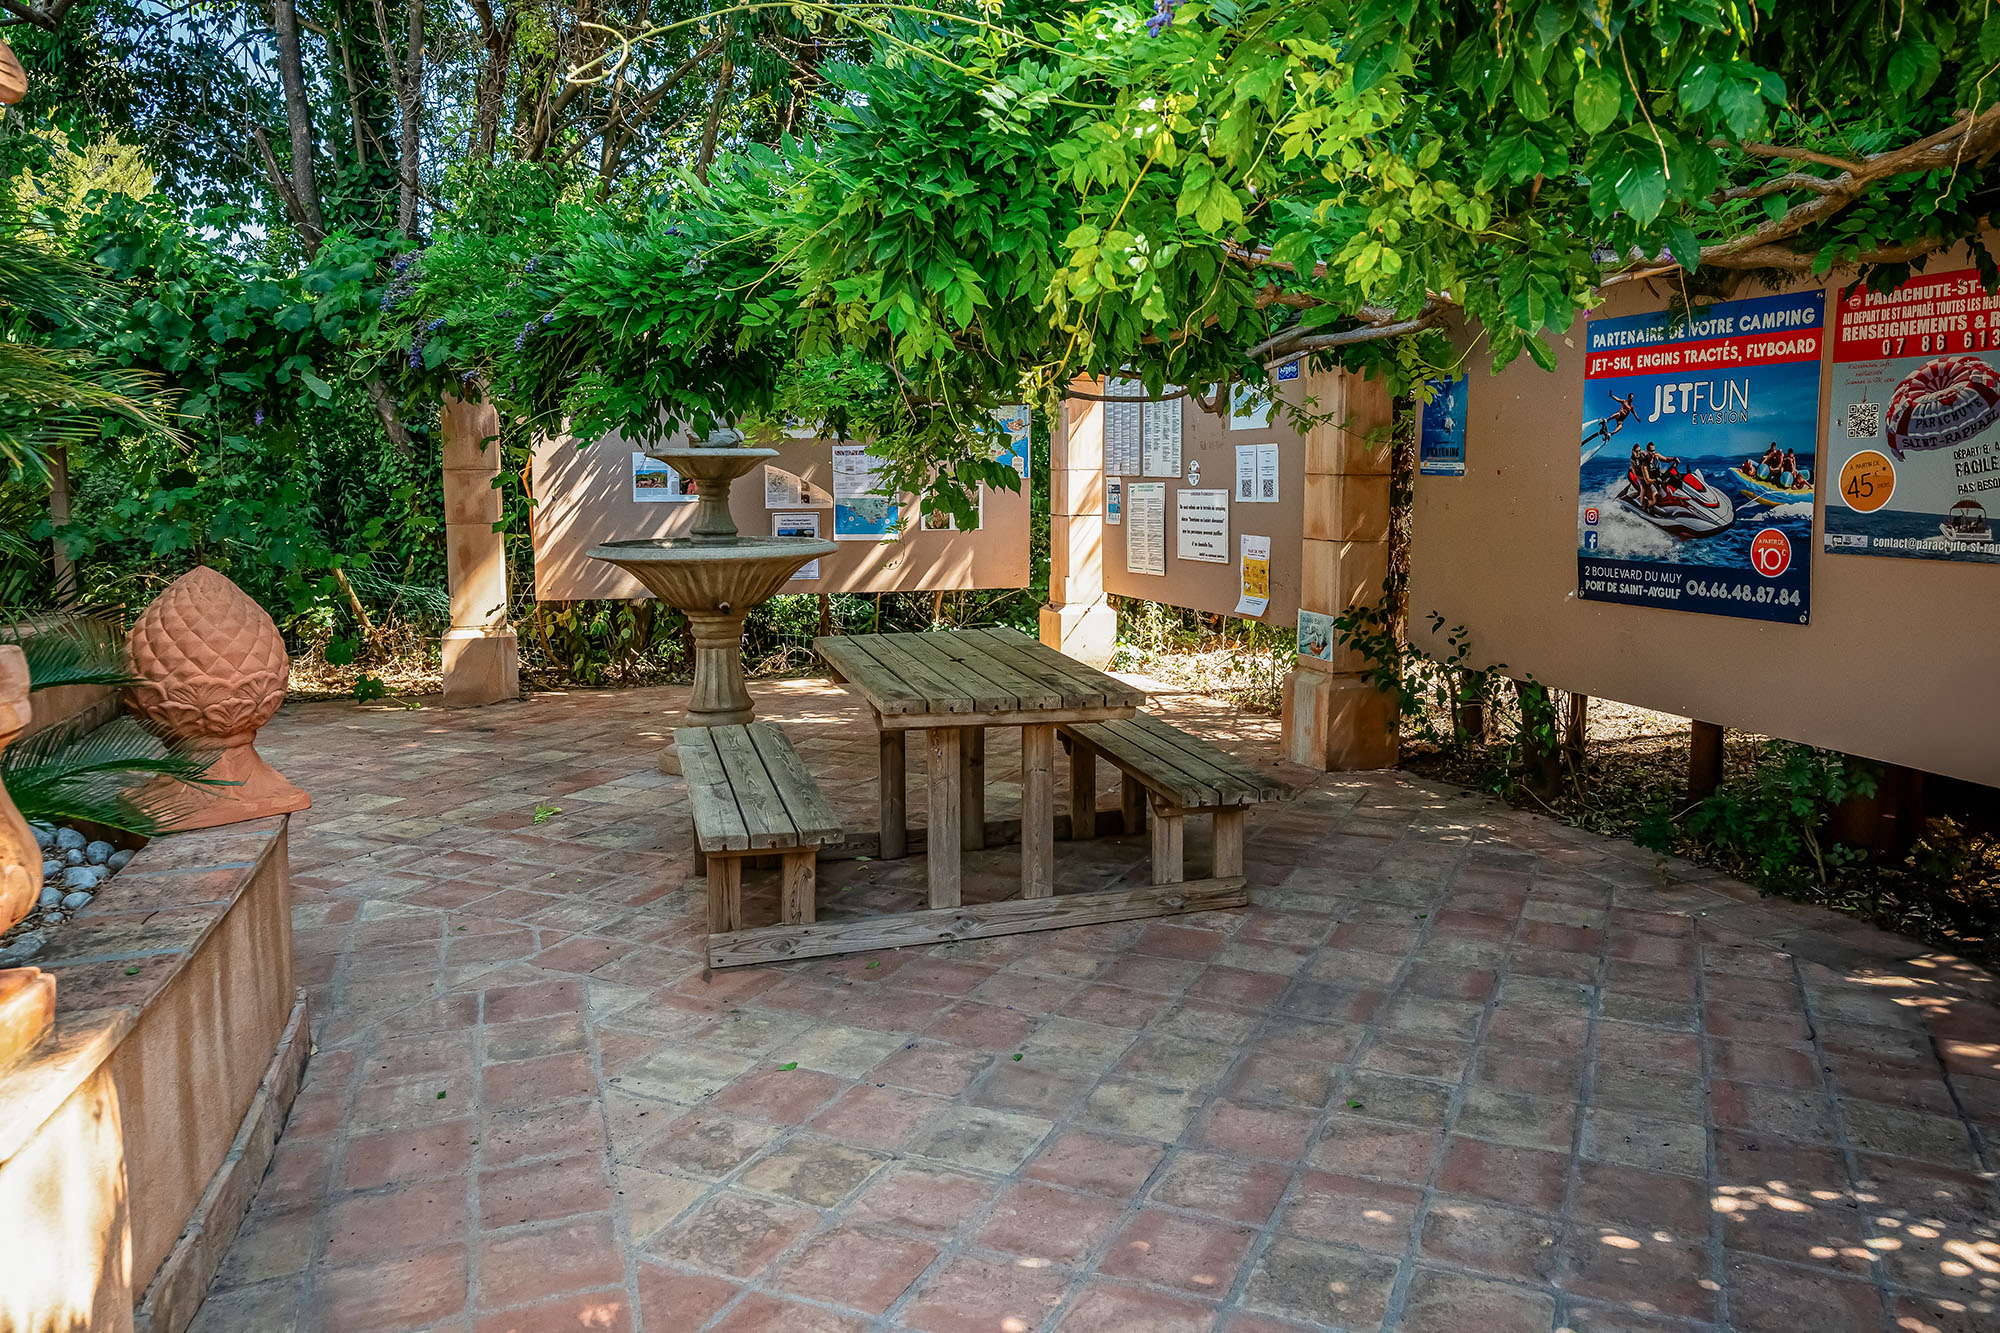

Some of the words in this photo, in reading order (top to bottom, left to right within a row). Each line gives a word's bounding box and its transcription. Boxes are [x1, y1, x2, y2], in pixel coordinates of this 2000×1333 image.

[1842, 312, 1853, 325] AU
[1881, 308, 1890, 321] DE
[1892, 306, 1901, 320] ST
[1936, 298, 1966, 316] TOUTES
[1967, 297, 1981, 311] LES
[1593, 326, 1664, 348] PARTENAIRE
[1690, 317, 1734, 337] VOTRE
[1739, 307, 1815, 331] CAMPING
[1842, 314, 1968, 342] RENSEIGNEMENTS
[1974, 314, 1986, 329] &
[1589, 356, 1634, 375] JET-SKI,
[1637, 351, 1680, 368] ENGINS
[1684, 340, 1742, 364] TRACTÉS,
[1746, 338, 1816, 359] FLYBOARD
[1692, 411, 1748, 425] EVASION
[1915, 398, 1983, 429] PARACHUTE
[1585, 565, 1590, 576] 2
[1592, 566, 1642, 581] BOULEVARD
[1644, 570, 1659, 582] DU
[1660, 572, 1682, 584] MUY
[1585, 580, 1606, 592] PORT
[1607, 583, 1618, 593] DE
[1619, 583, 1682, 599] SAINT-AYGULF
[1685, 579, 1801, 607] 06.66.48.87.84
